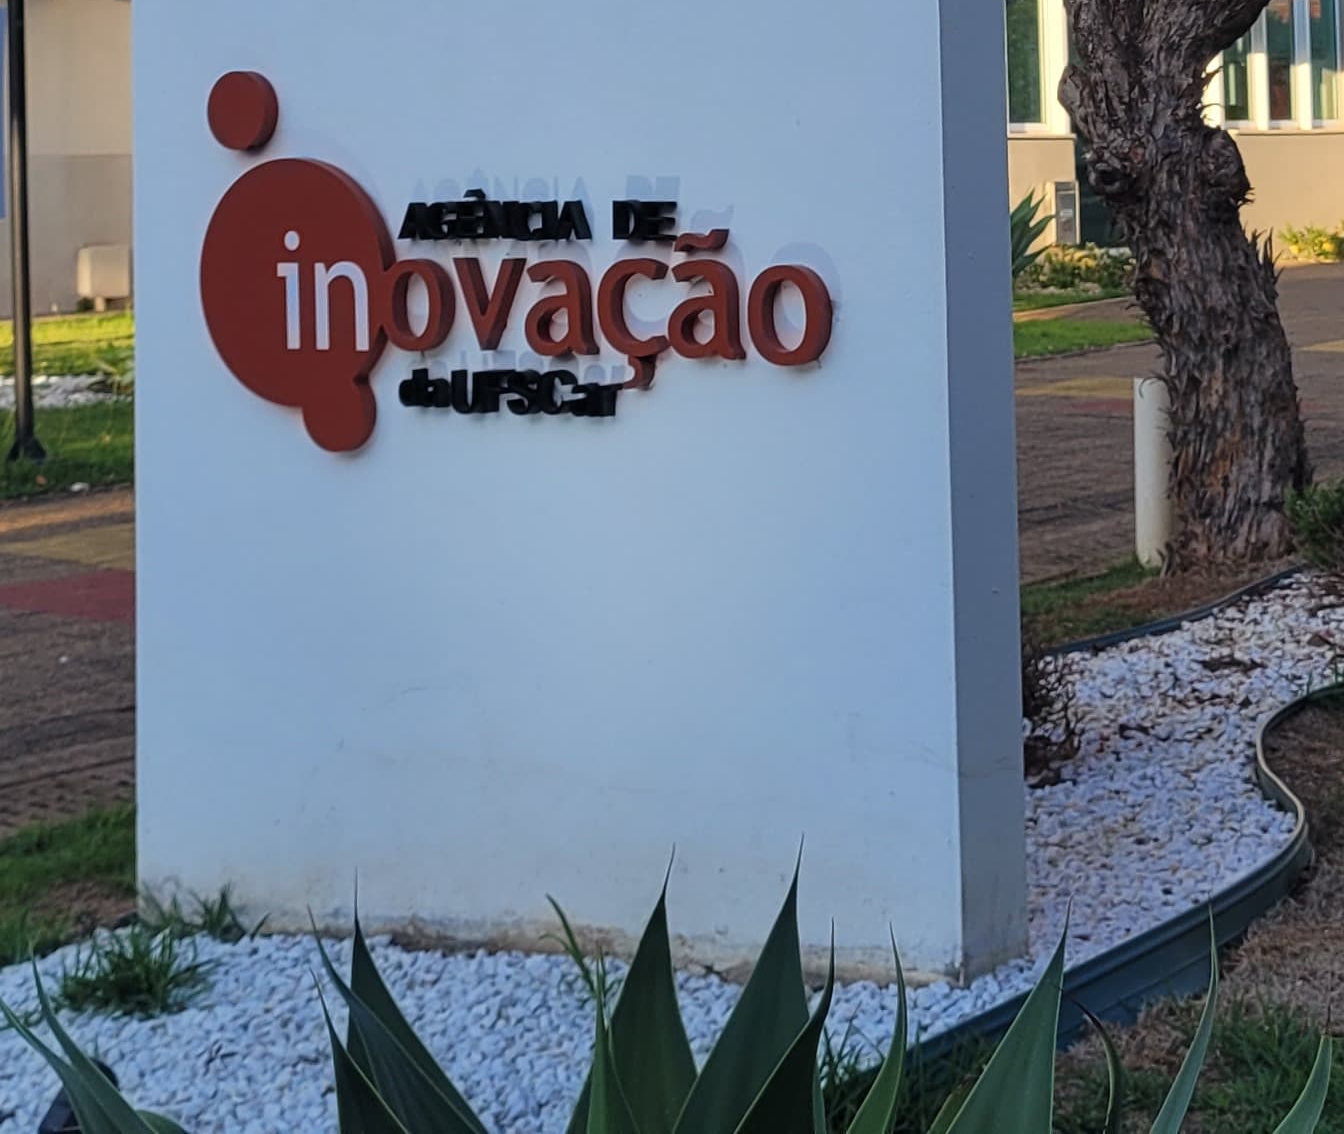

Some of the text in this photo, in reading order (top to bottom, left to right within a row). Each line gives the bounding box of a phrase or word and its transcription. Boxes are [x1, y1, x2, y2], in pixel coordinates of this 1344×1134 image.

[398, 188, 678, 241] AGÊNCIA DE
[276, 228, 833, 391] inovação
